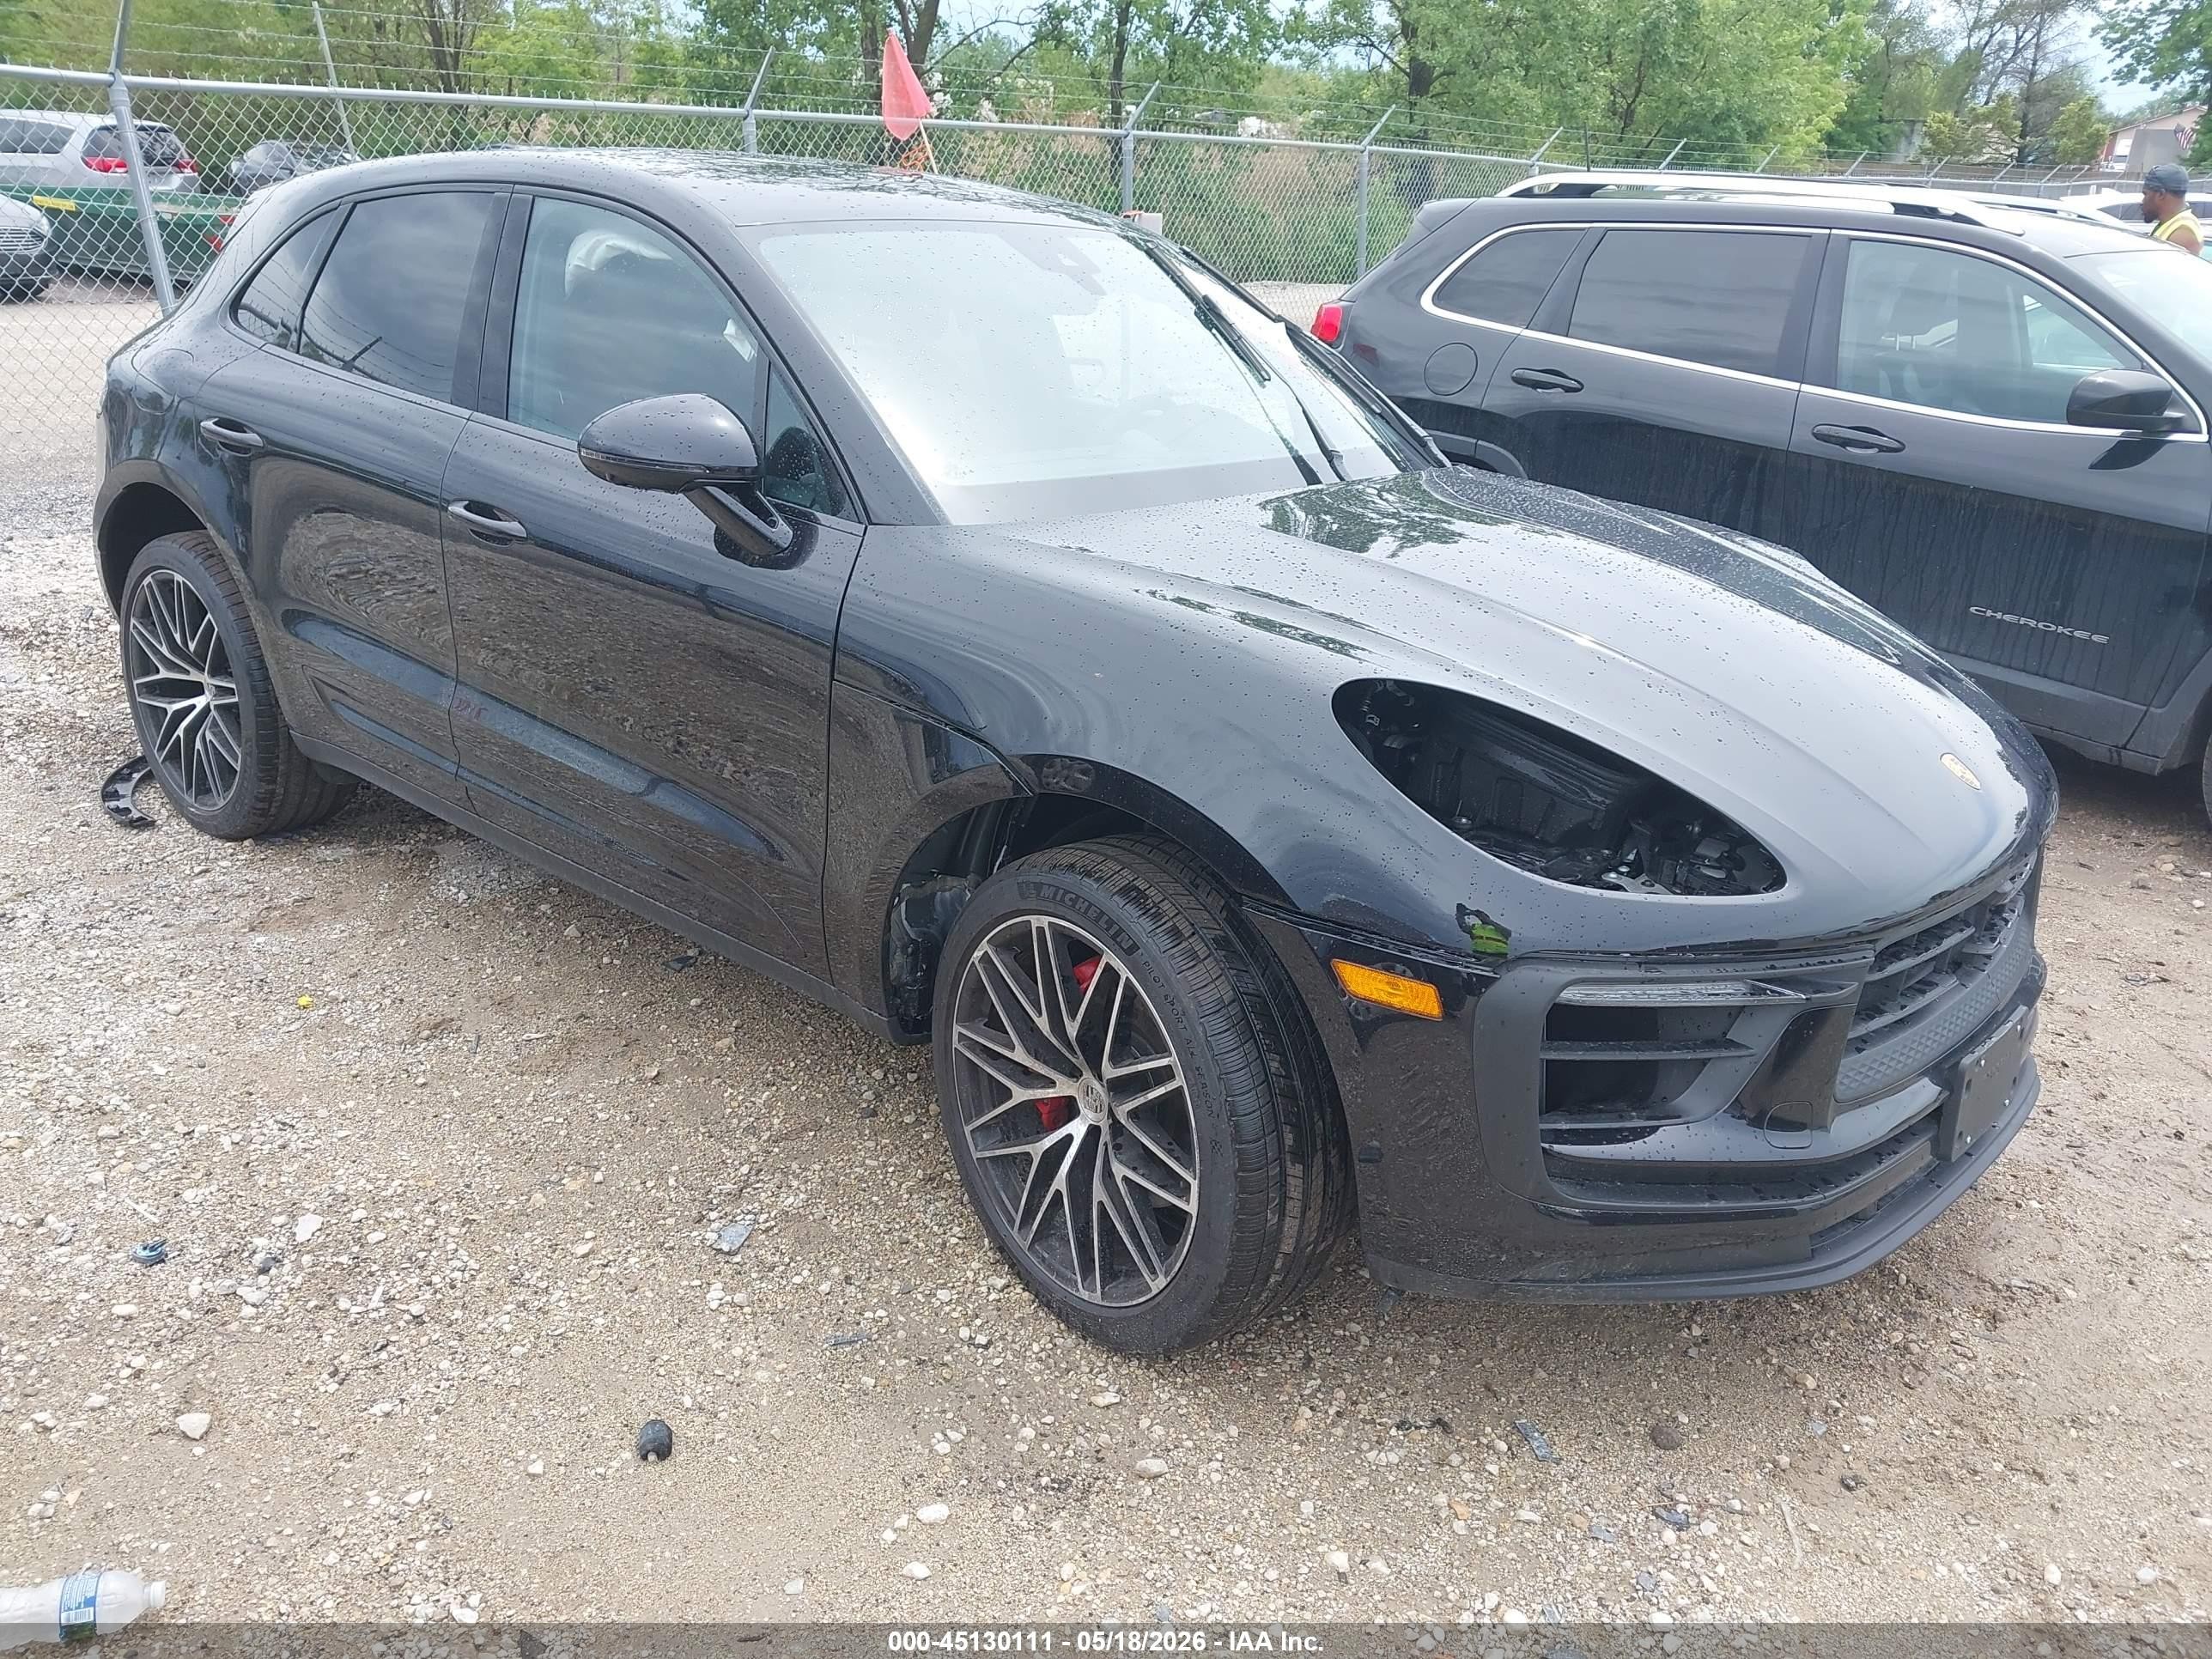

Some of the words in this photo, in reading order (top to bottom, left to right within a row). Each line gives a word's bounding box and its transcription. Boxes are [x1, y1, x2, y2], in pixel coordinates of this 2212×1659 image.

[1969, 606, 2110, 644] CHEROKEE
[1040, 883, 1134, 951] MICHELIN
[1141, 961, 1166, 989] PILOT
[1164, 994, 1188, 1031] SPORT
